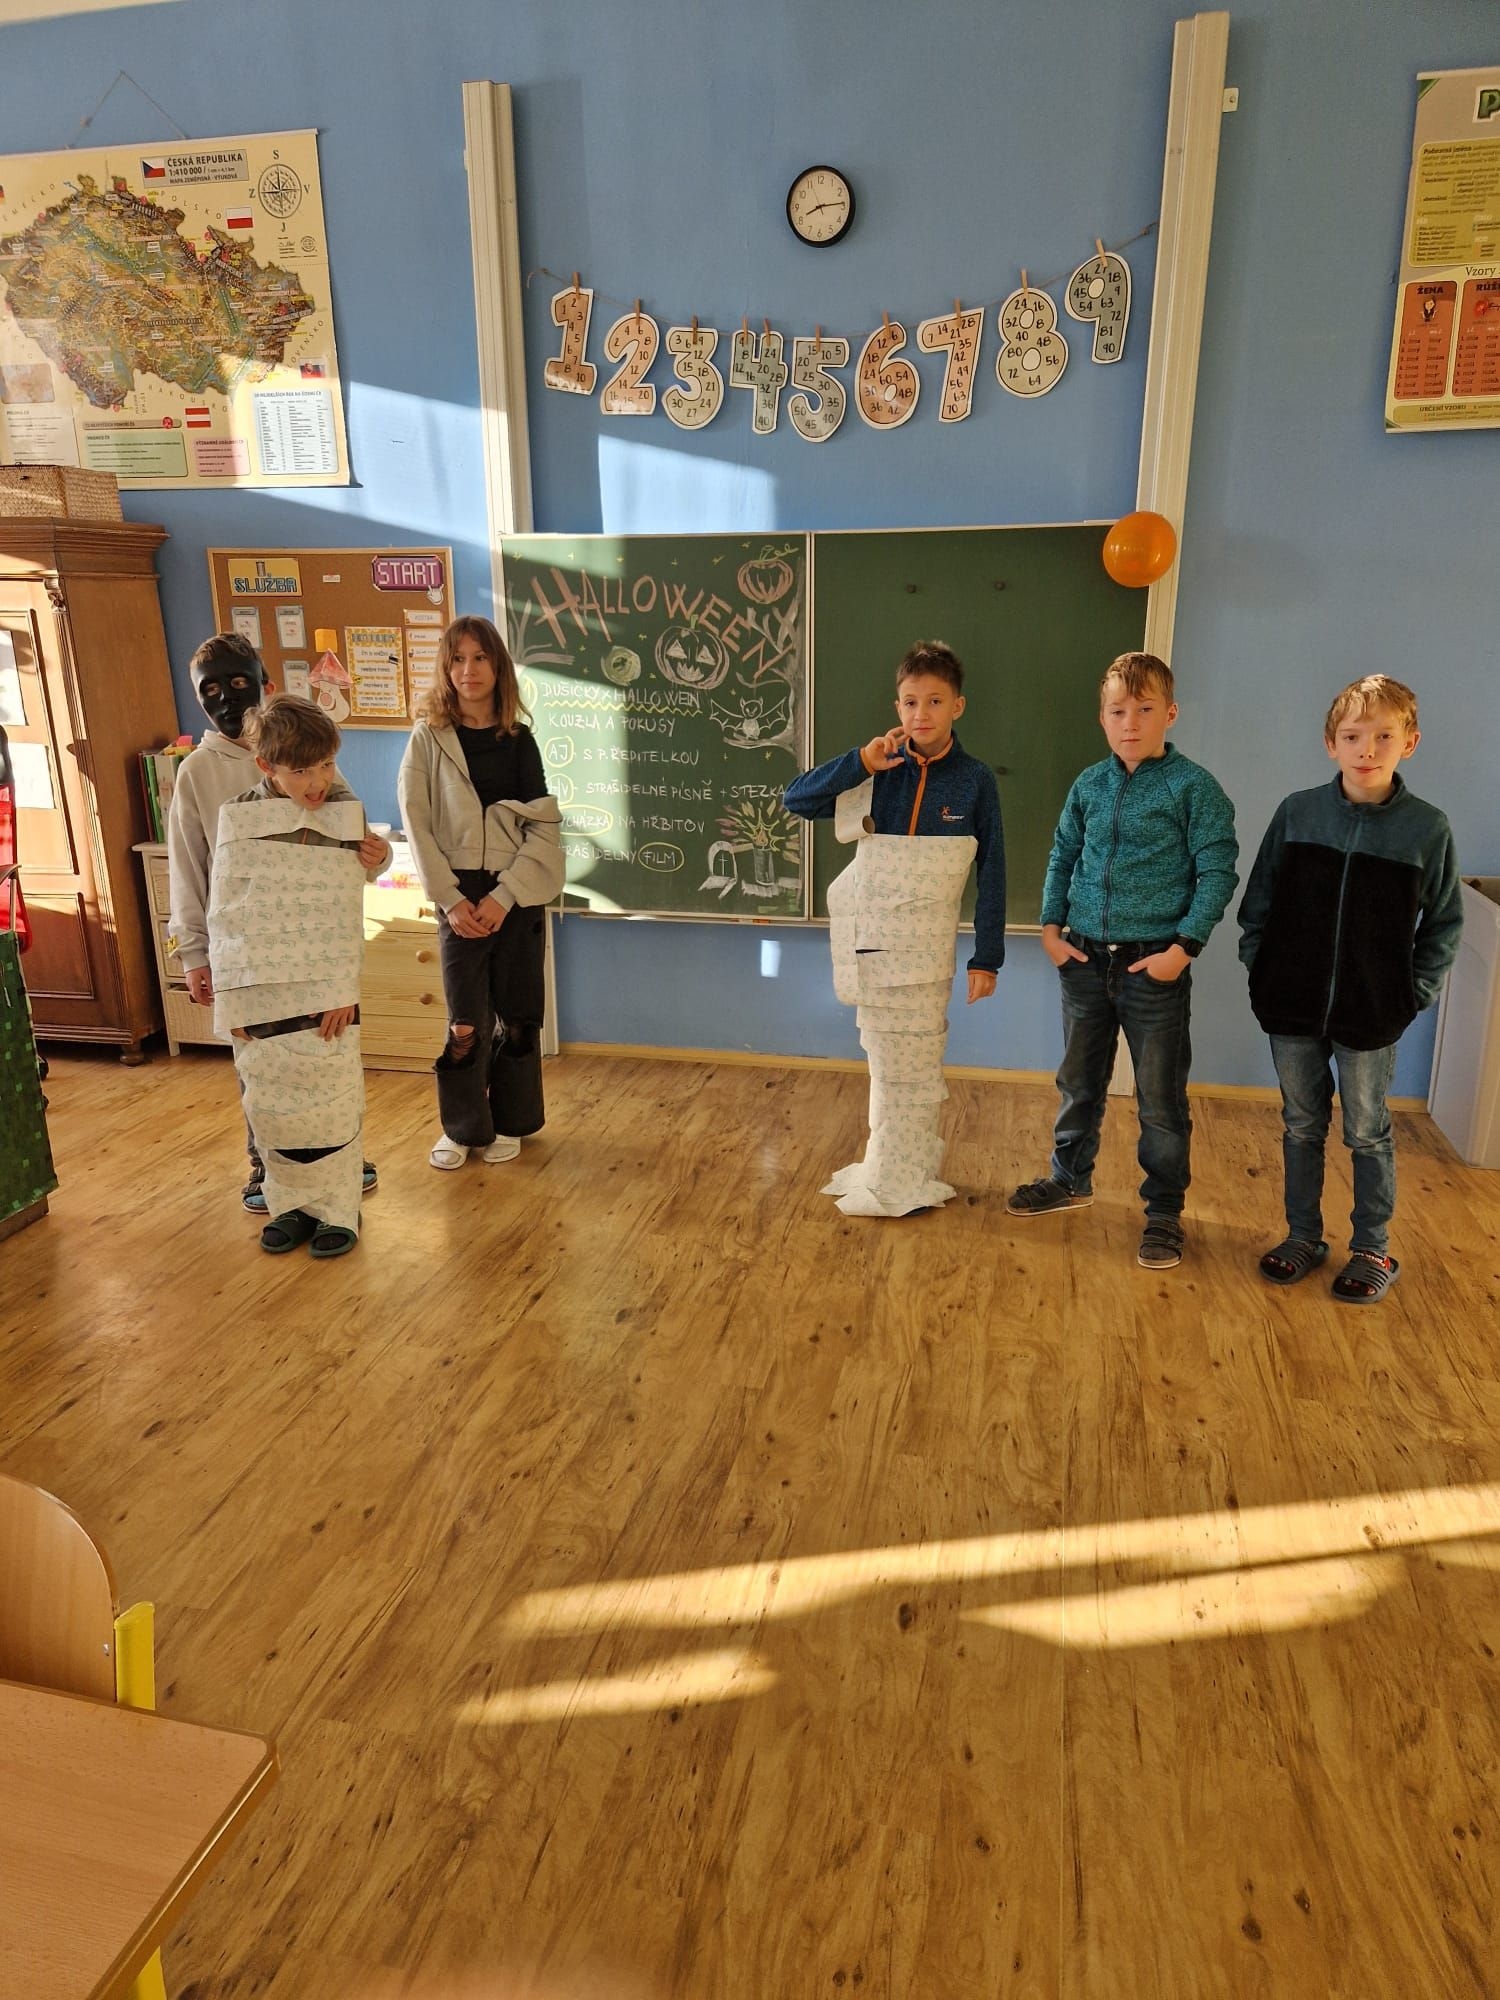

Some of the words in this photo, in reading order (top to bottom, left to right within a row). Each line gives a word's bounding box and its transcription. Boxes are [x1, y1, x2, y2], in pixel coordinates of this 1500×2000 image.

[167, 156, 194, 167] ČESKÁ
[196, 153, 243, 165] REPUBLIKA
[273, 150, 279, 160] S
[169, 168, 188, 176] 1:410
[189, 167, 202, 175] 000
[807, 179, 813, 189] 11
[817, 175, 825, 185] 12
[249, 188, 256, 199] Z
[303, 184, 311, 194] V
[800, 190, 806, 199] 10
[837, 187, 842, 197] 2
[794, 203, 800, 211] 9
[840, 201, 846, 211] 3
[798, 216, 804, 225] 8
[281, 222, 287, 233] J
[808, 225, 813, 235] 7
[817, 228, 822, 238] 6
[828, 225, 834, 234] 5
[1466, 266, 1496, 277] Vzory
[1078, 272, 1092, 283] 36
[1108, 272, 1121, 283] 18
[1073, 288, 1088, 299] 45
[1114, 286, 1120, 297] 9
[1417, 286, 1443, 295] ŽENA
[571, 298, 577, 308] 2
[1014, 299, 1028, 311] 24
[1033, 300, 1045, 312] 16
[1079, 301, 1093, 312] 54
[1100, 298, 1114, 308] 63
[562, 304, 567, 315] 1
[577, 311, 583, 321] 3
[1111, 310, 1122, 321] 72
[569, 321, 574, 332] 4
[961, 317, 976, 329] 28
[1005, 317, 1019, 329] 32
[1036, 318, 1045, 330] 8
[624, 326, 630, 336] 4
[638, 326, 644, 335] 6
[937, 323, 948, 335] 14
[950, 328, 961, 340] 21
[1100, 326, 1113, 337] 81
[574, 333, 580, 343] 5
[644, 336, 651, 346] 8
[675, 334, 682, 345] 3
[698, 336, 704, 346] 9
[891, 330, 898, 341] 6
[928, 333, 934, 344] 7
[1015, 331, 1029, 342] 40
[614, 337, 620, 347] 2
[685, 339, 691, 349] 6
[877, 338, 888, 349] 12
[958, 338, 972, 350] 35
[1036, 336, 1052, 348] 48
[567, 345, 573, 354] 6
[764, 348, 776, 358] 24
[835, 345, 842, 356] 5
[1007, 346, 1023, 358] 80
[1102, 343, 1116, 354] 90
[572, 355, 577, 365] 7
[639, 350, 649, 361] 10
[694, 350, 704, 360] 12
[741, 351, 750, 360] 8
[821, 350, 832, 360] 10
[867, 352, 880, 364] 18
[953, 351, 966, 363] 42
[1045, 355, 1060, 366] 56
[683, 361, 694, 372] 15
[797, 356, 810, 367] 20
[564, 364, 571, 374] 8
[630, 364, 640, 375] 12
[698, 366, 710, 377] 18
[735, 362, 745, 373] 12
[757, 364, 770, 374] 20
[957, 365, 969, 377] 49
[576, 372, 586, 383] 10
[745, 371, 756, 382] 16
[769, 372, 784, 383] 28
[802, 371, 815, 382] 25
[863, 369, 876, 380] 24
[896, 370, 909, 381] 54
[1008, 368, 1020, 379] 72
[619, 379, 628, 390] 14
[879, 374, 892, 385] 60
[950, 378, 963, 389] 56
[1028, 375, 1042, 387] 64
[705, 381, 716, 392] 21
[759, 383, 771, 394] 32
[818, 380, 831, 391] 30
[638, 390, 650, 400] 20
[899, 387, 914, 399] 48
[953, 391, 966, 402] 63
[671, 398, 684, 409] 30
[699, 398, 711, 408] 24
[761, 399, 774, 410] 36
[826, 397, 840, 408] 35
[870, 401, 883, 413] 36
[686, 408, 697, 418] 27
[793, 406, 807, 416] 50
[947, 403, 959, 415] 70
[758, 416, 770, 426] 40
[805, 419, 817, 430] 45
[377, 561, 438, 586] START
[531, 567, 794, 680] HALLOWEEN
[541, 680, 599, 698] DUŠIČKY
[550, 714, 600, 730] KOUZLA
[605, 717, 615, 730] A
[622, 717, 677, 737] POKUSY
[549, 744, 569, 760] AJ
[584, 749, 593, 760] S
[586, 777, 667, 798] STRAŠIDELNÉ
[672, 780, 713, 801] PÍSNĚ
[731, 784, 785, 798] STEZKA
[617, 817, 637, 830] NA
[642, 816, 706, 834] HŘBITOV
[643, 851, 676, 867] FILM
